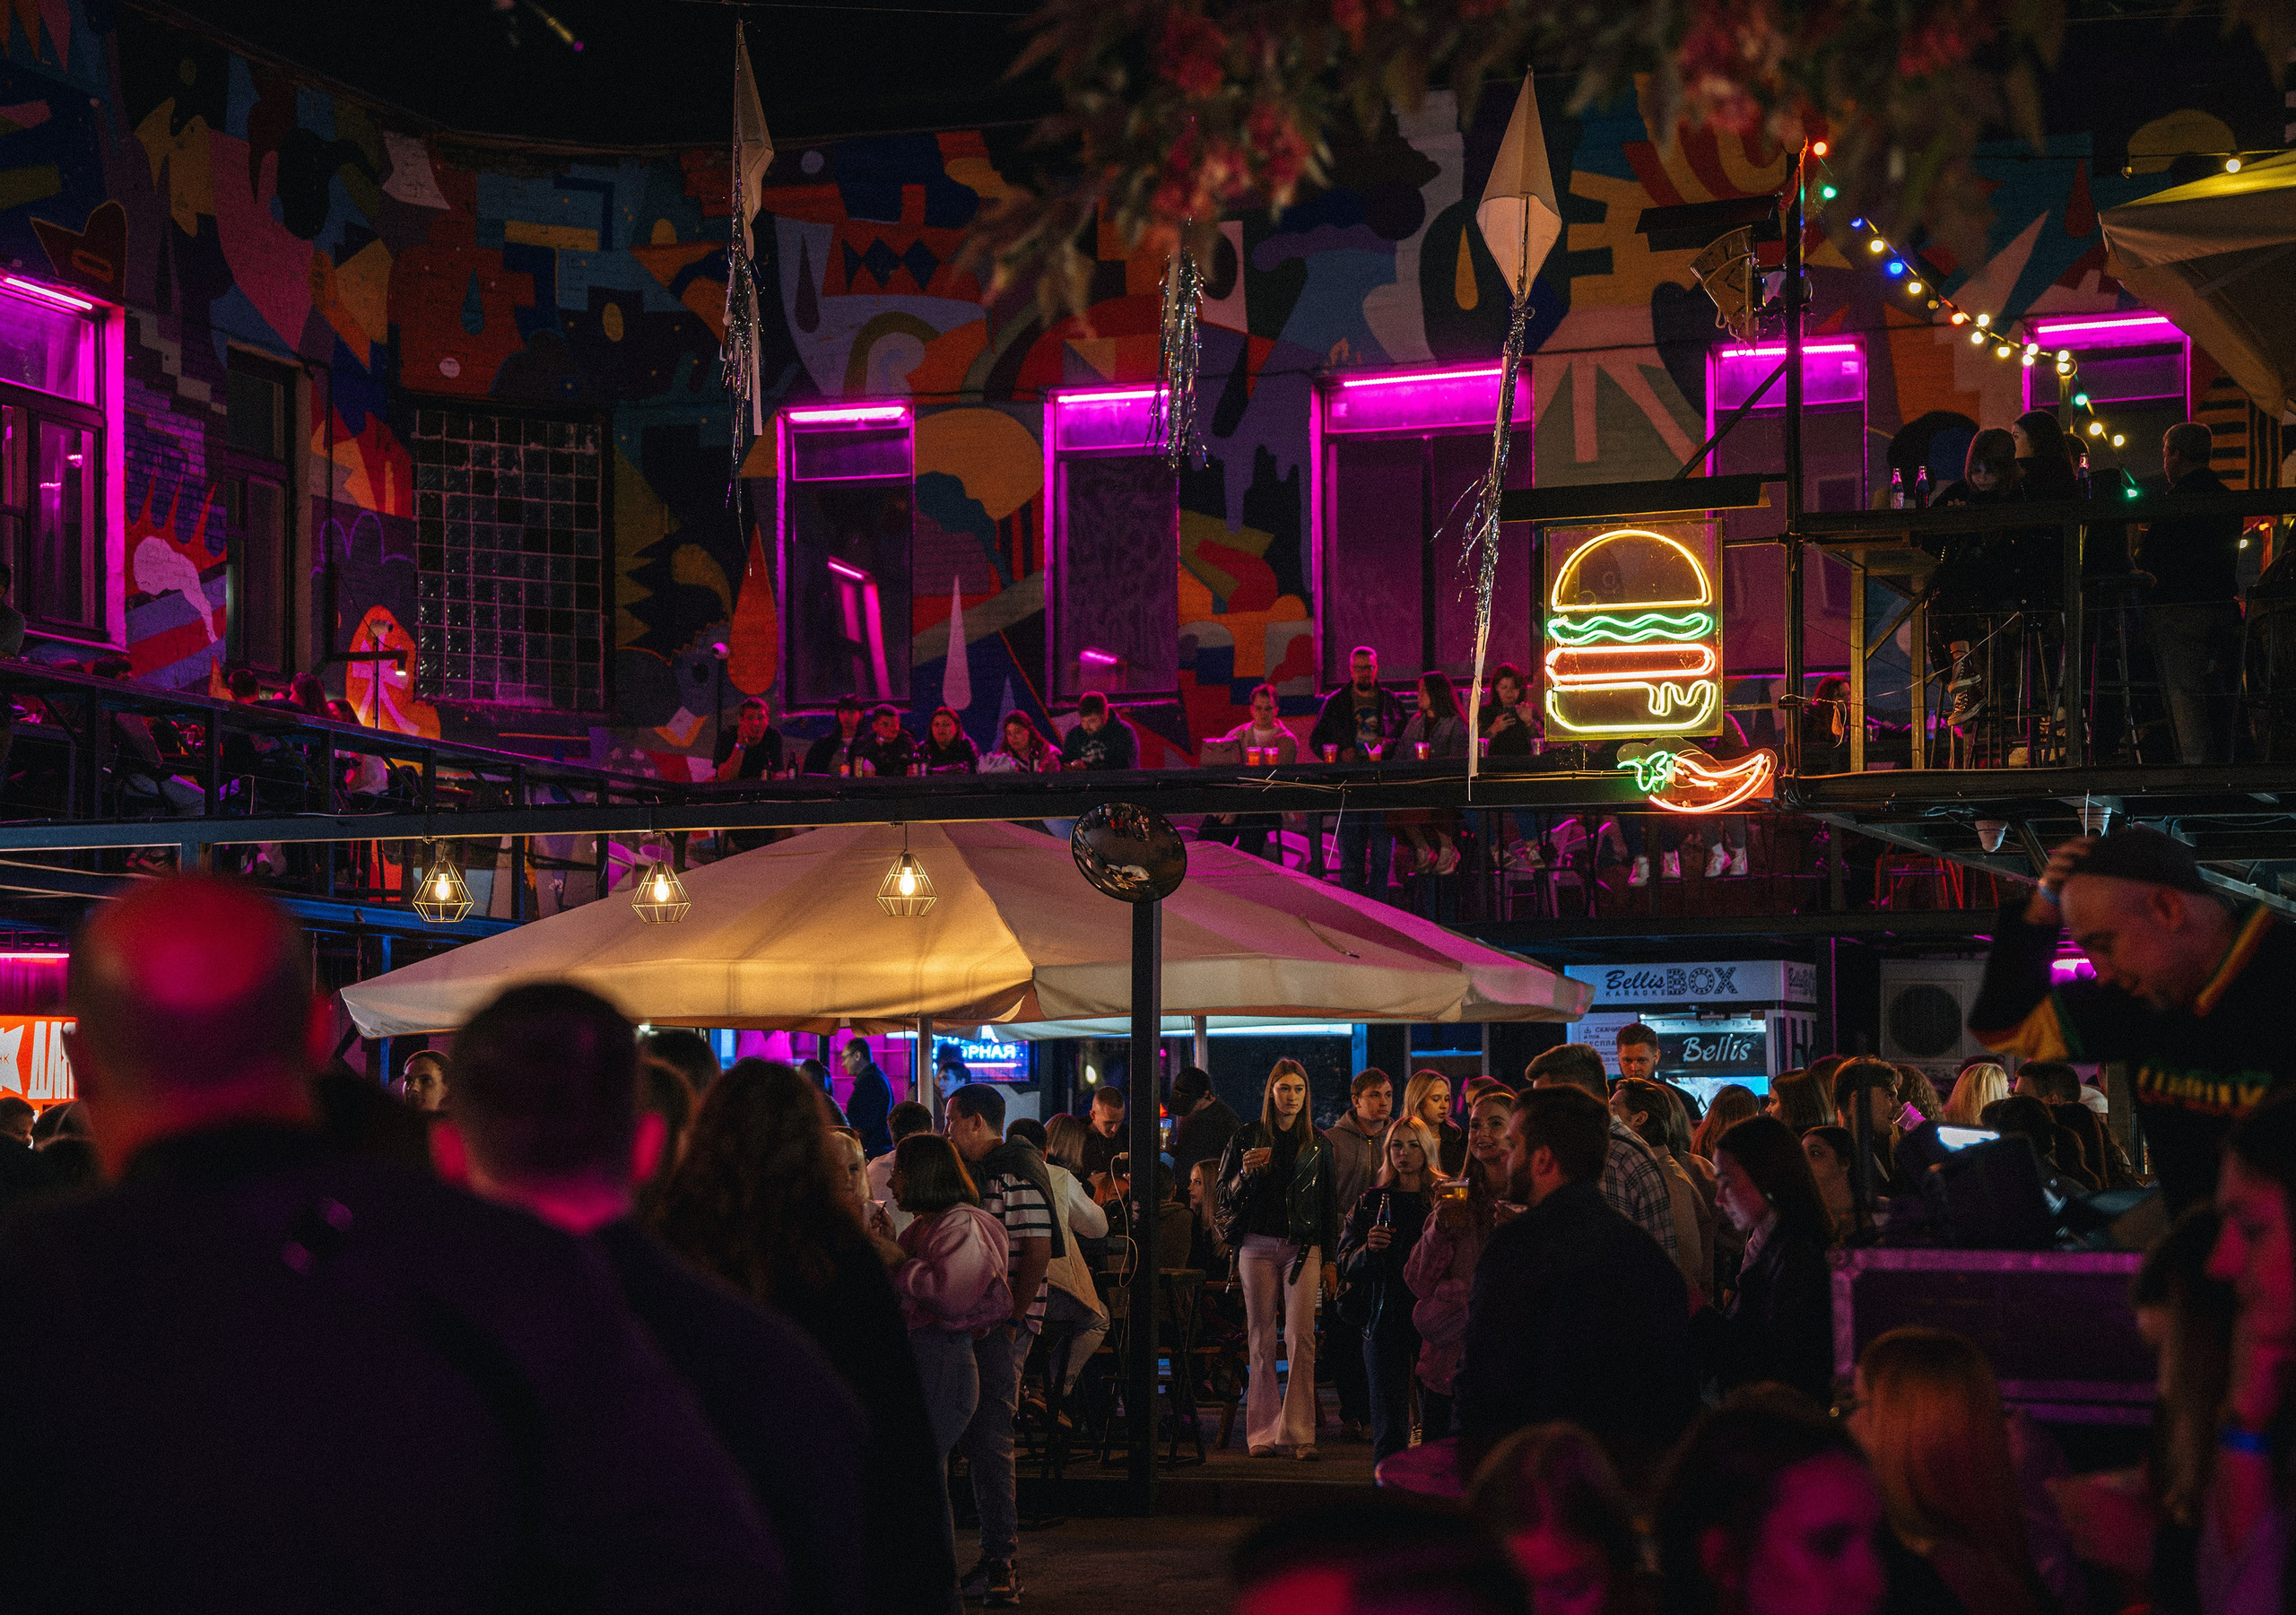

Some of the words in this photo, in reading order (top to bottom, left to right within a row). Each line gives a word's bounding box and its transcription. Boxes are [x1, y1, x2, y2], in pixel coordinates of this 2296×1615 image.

[1605, 969, 1665, 989] Bellis
[1666, 967, 1738, 995] BOX
[1683, 1036, 1752, 1063] Bellis
